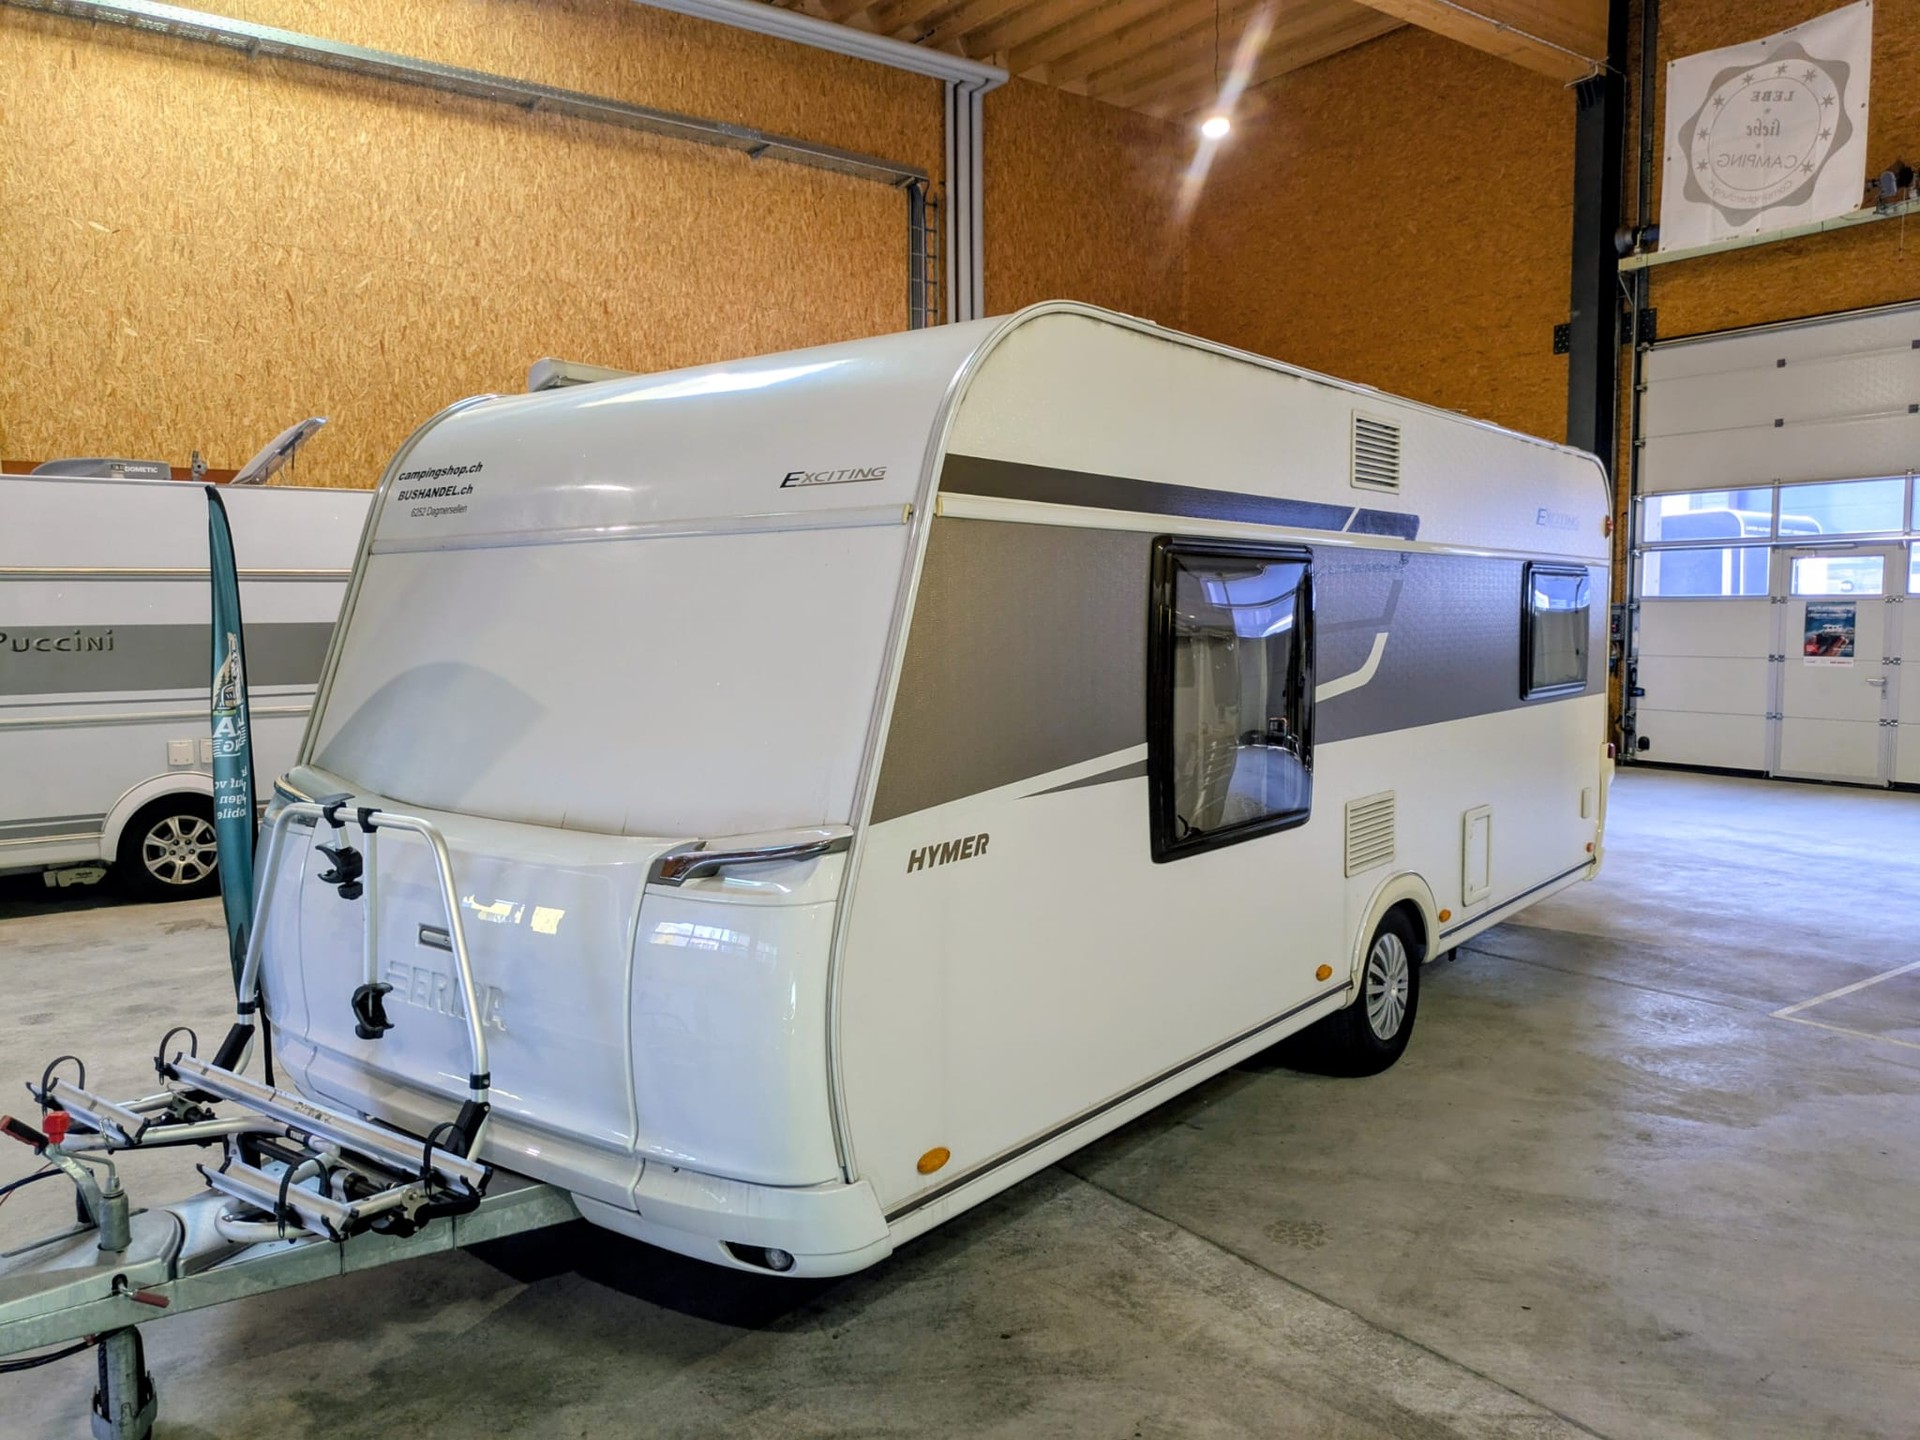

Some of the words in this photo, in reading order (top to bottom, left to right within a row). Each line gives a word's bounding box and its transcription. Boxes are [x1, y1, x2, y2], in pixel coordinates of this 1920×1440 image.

[124, 465, 158, 473] DOMETIC
[398, 461, 484, 481] campingshop.ch
[397, 484, 474, 501] BUSHANDEL.ch
[906, 832, 990, 874] HYMER
